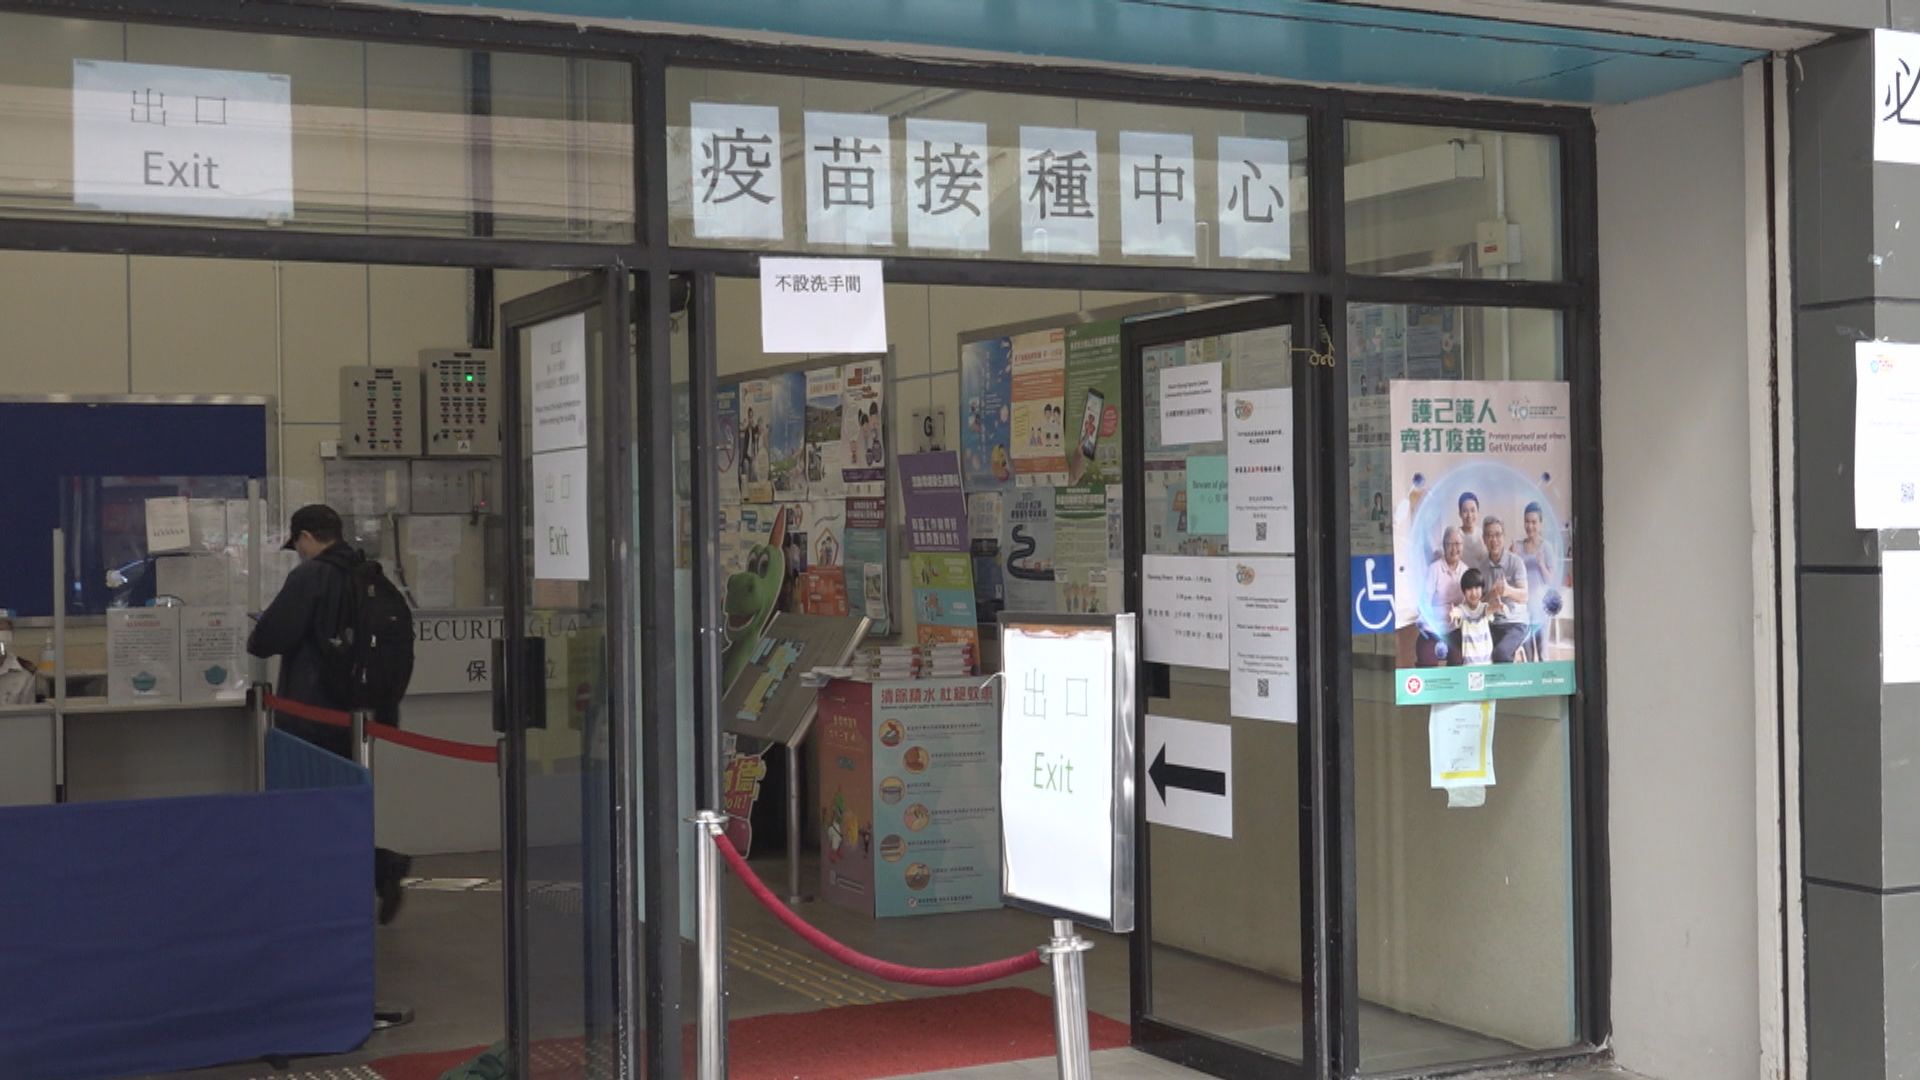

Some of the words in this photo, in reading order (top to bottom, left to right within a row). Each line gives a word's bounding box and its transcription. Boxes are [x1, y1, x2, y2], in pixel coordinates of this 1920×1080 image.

[130, 87, 228, 127] 出口
[142, 150, 221, 191] Exit
[700, 127, 1285, 225] 疫苗接種中心
[774, 273, 862, 294] 不設洗手間
[1411, 398, 1497, 424] 護己護人
[1400, 427, 1486, 453] 齊打疫苗
[1489, 443, 1503, 453] Get
[1504, 442, 1547, 453] Vaccinated
[550, 526, 569, 557] Exit
[1023, 667, 1089, 720] 出口
[1033, 751, 1074, 794] Exit
